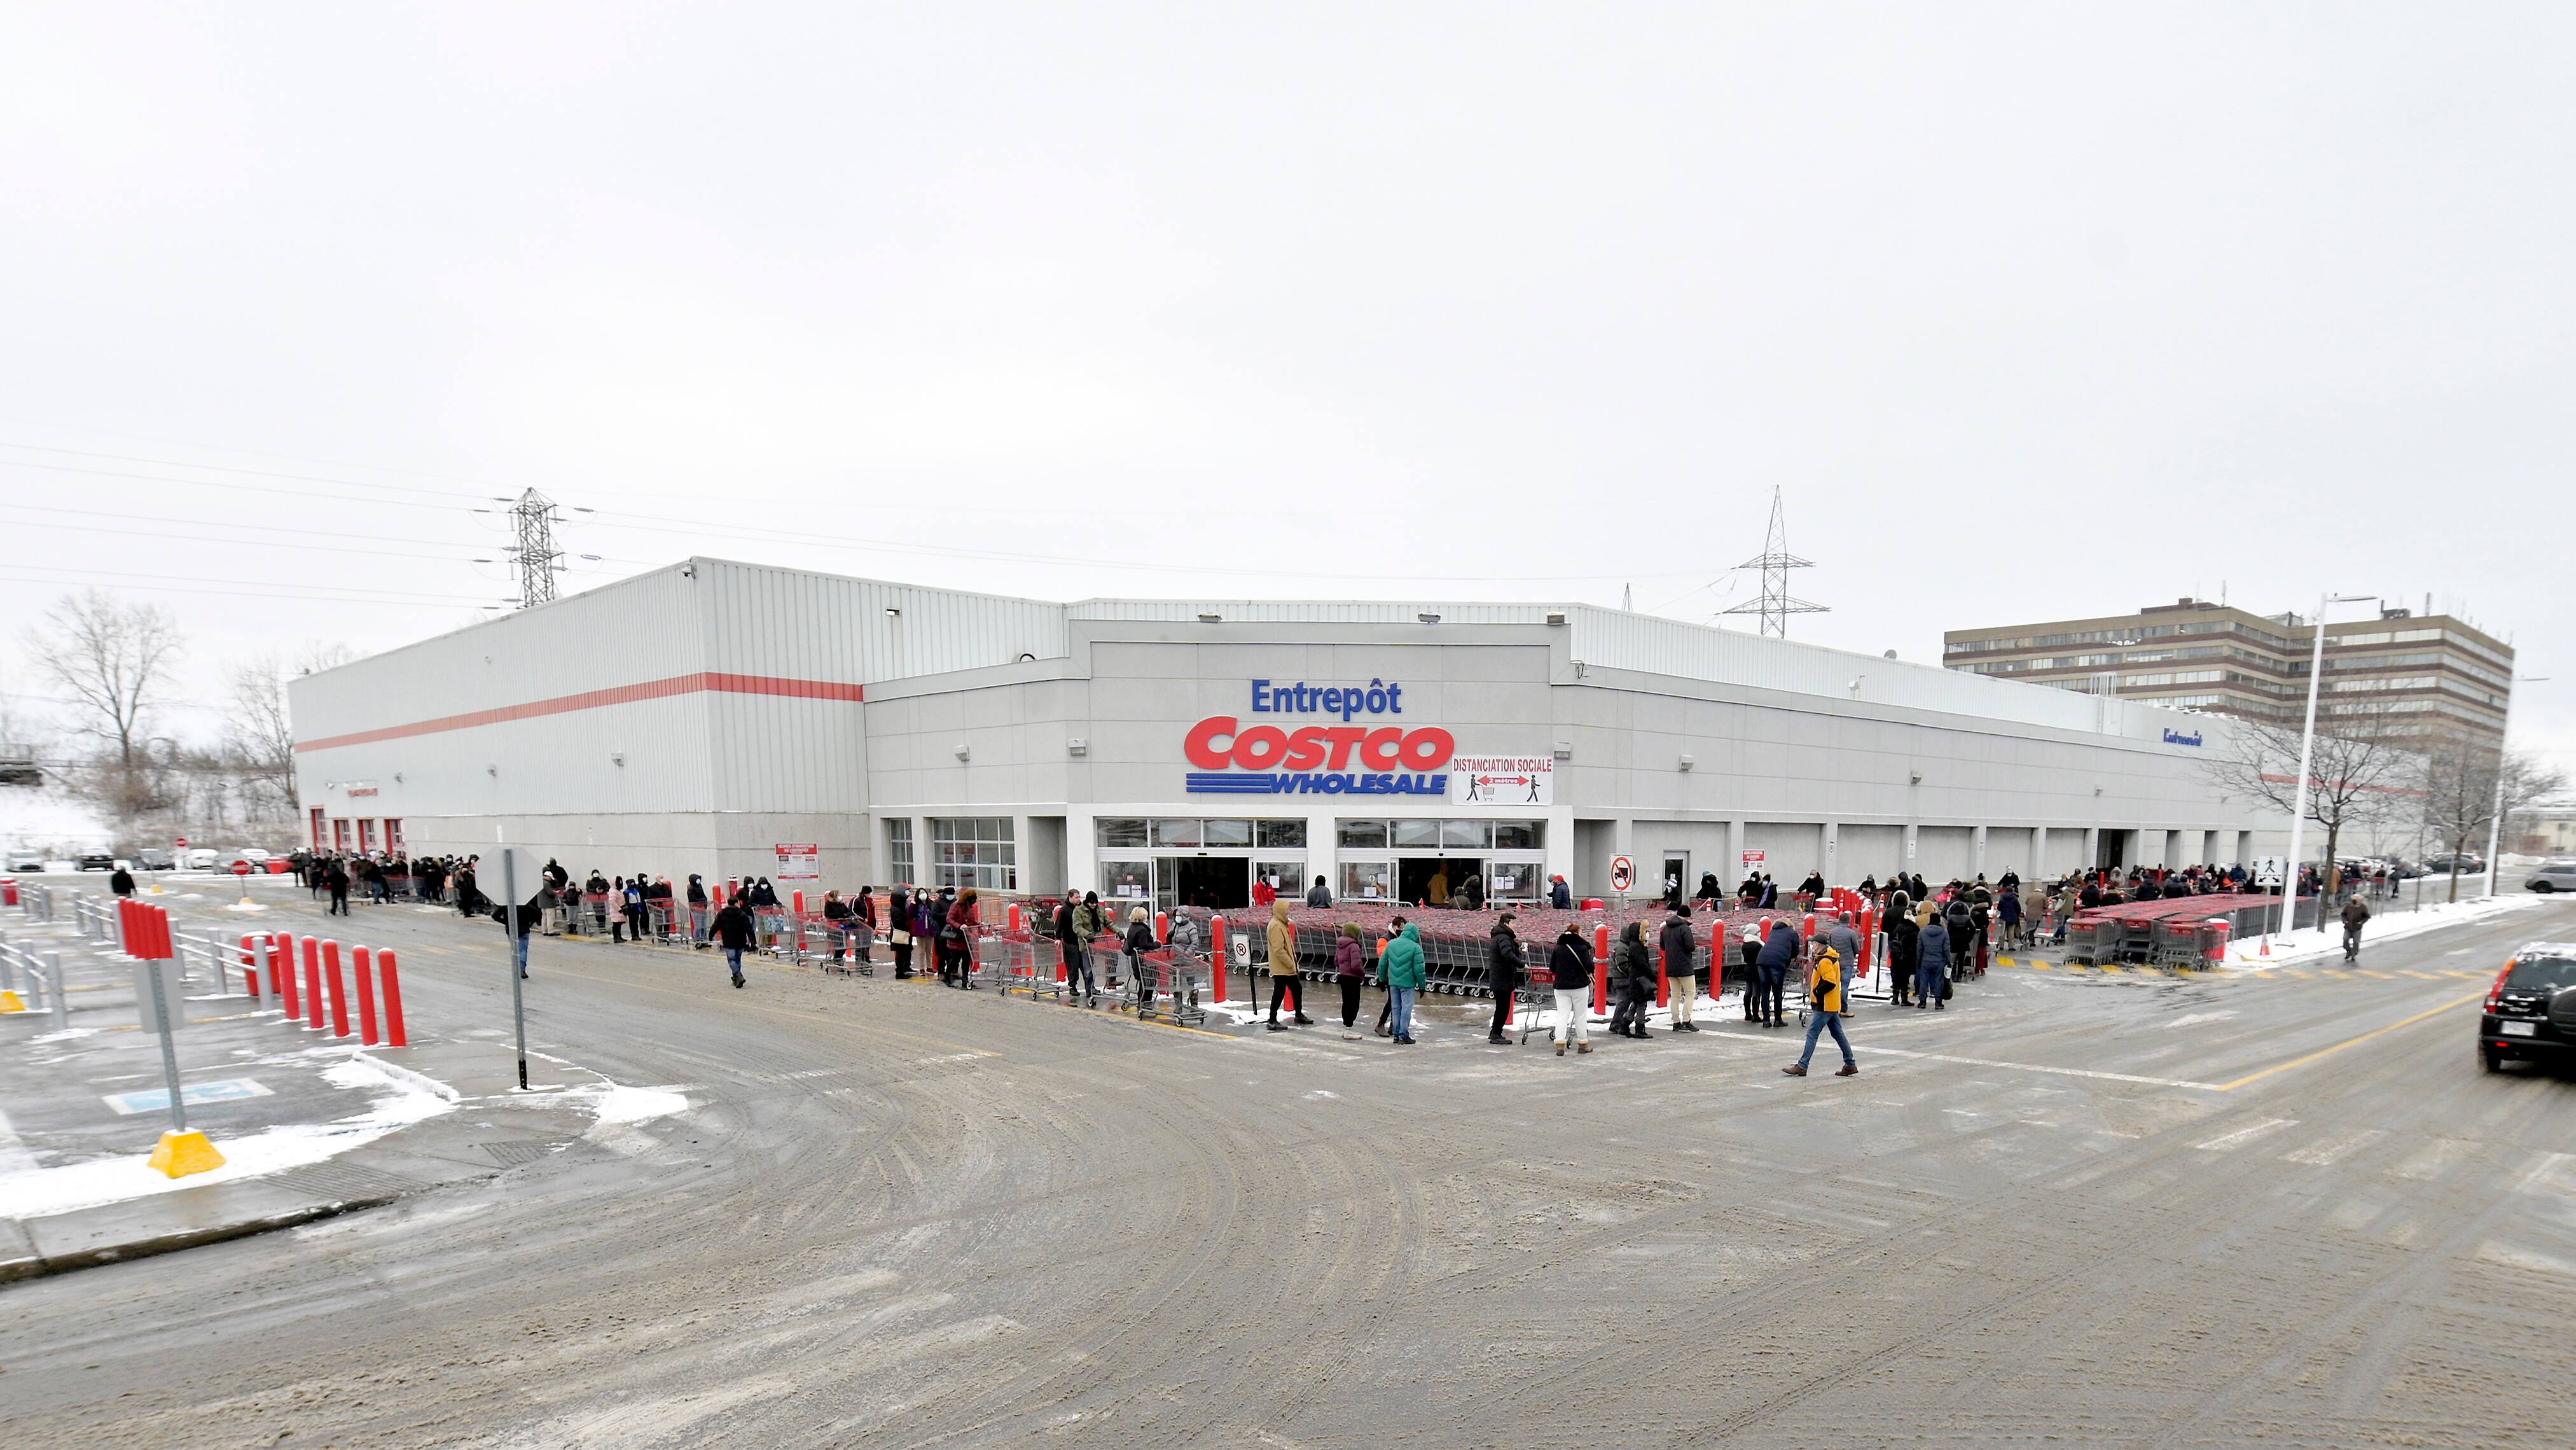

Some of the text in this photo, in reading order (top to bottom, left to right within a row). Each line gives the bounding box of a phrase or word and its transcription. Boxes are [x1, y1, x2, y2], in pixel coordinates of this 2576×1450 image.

[1252, 678, 1402, 722] Entrepôt
[1184, 716, 1455, 771] COSTCO
[1453, 758, 1552, 772] DISTANCIATION SOCIALE
[1269, 773, 1448, 795] WHOLESALE
